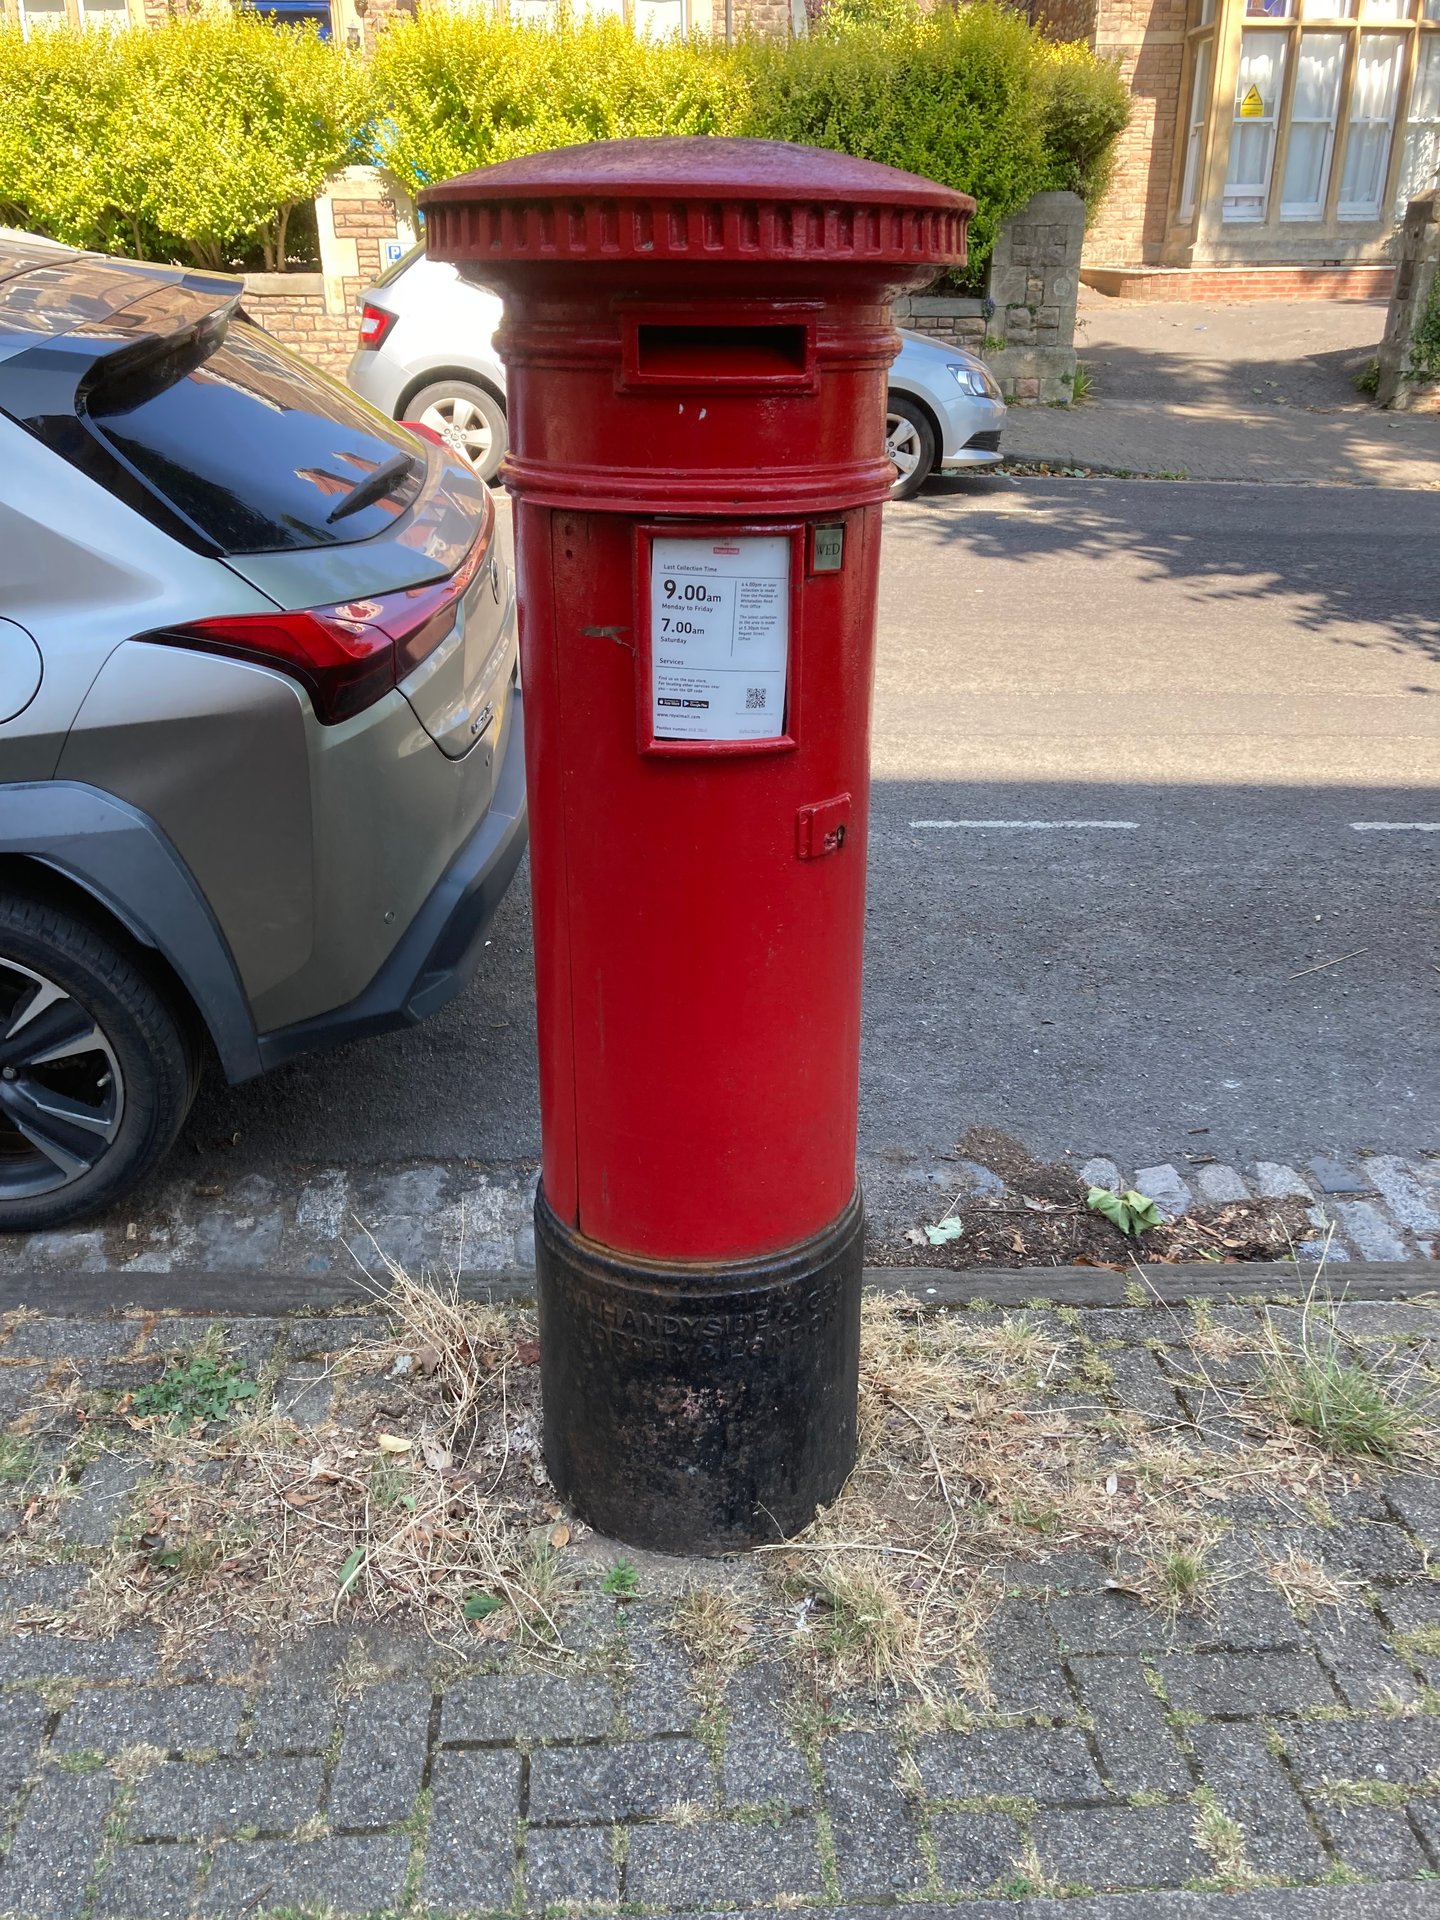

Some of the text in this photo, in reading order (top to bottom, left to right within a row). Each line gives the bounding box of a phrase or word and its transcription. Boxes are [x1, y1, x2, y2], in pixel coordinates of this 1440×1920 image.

[816, 543, 841, 556] WED
[676, 564, 703, 572] Collection
[664, 579, 721, 602] 9.00am
[661, 603, 685, 611] Monday
[694, 605, 713, 613] Friday
[661, 618, 705, 635] 7.00am
[660, 636, 687, 645] Saturday
[659, 658, 684, 666] Services
[601, 1299, 769, 1337] HANDYSIDE
